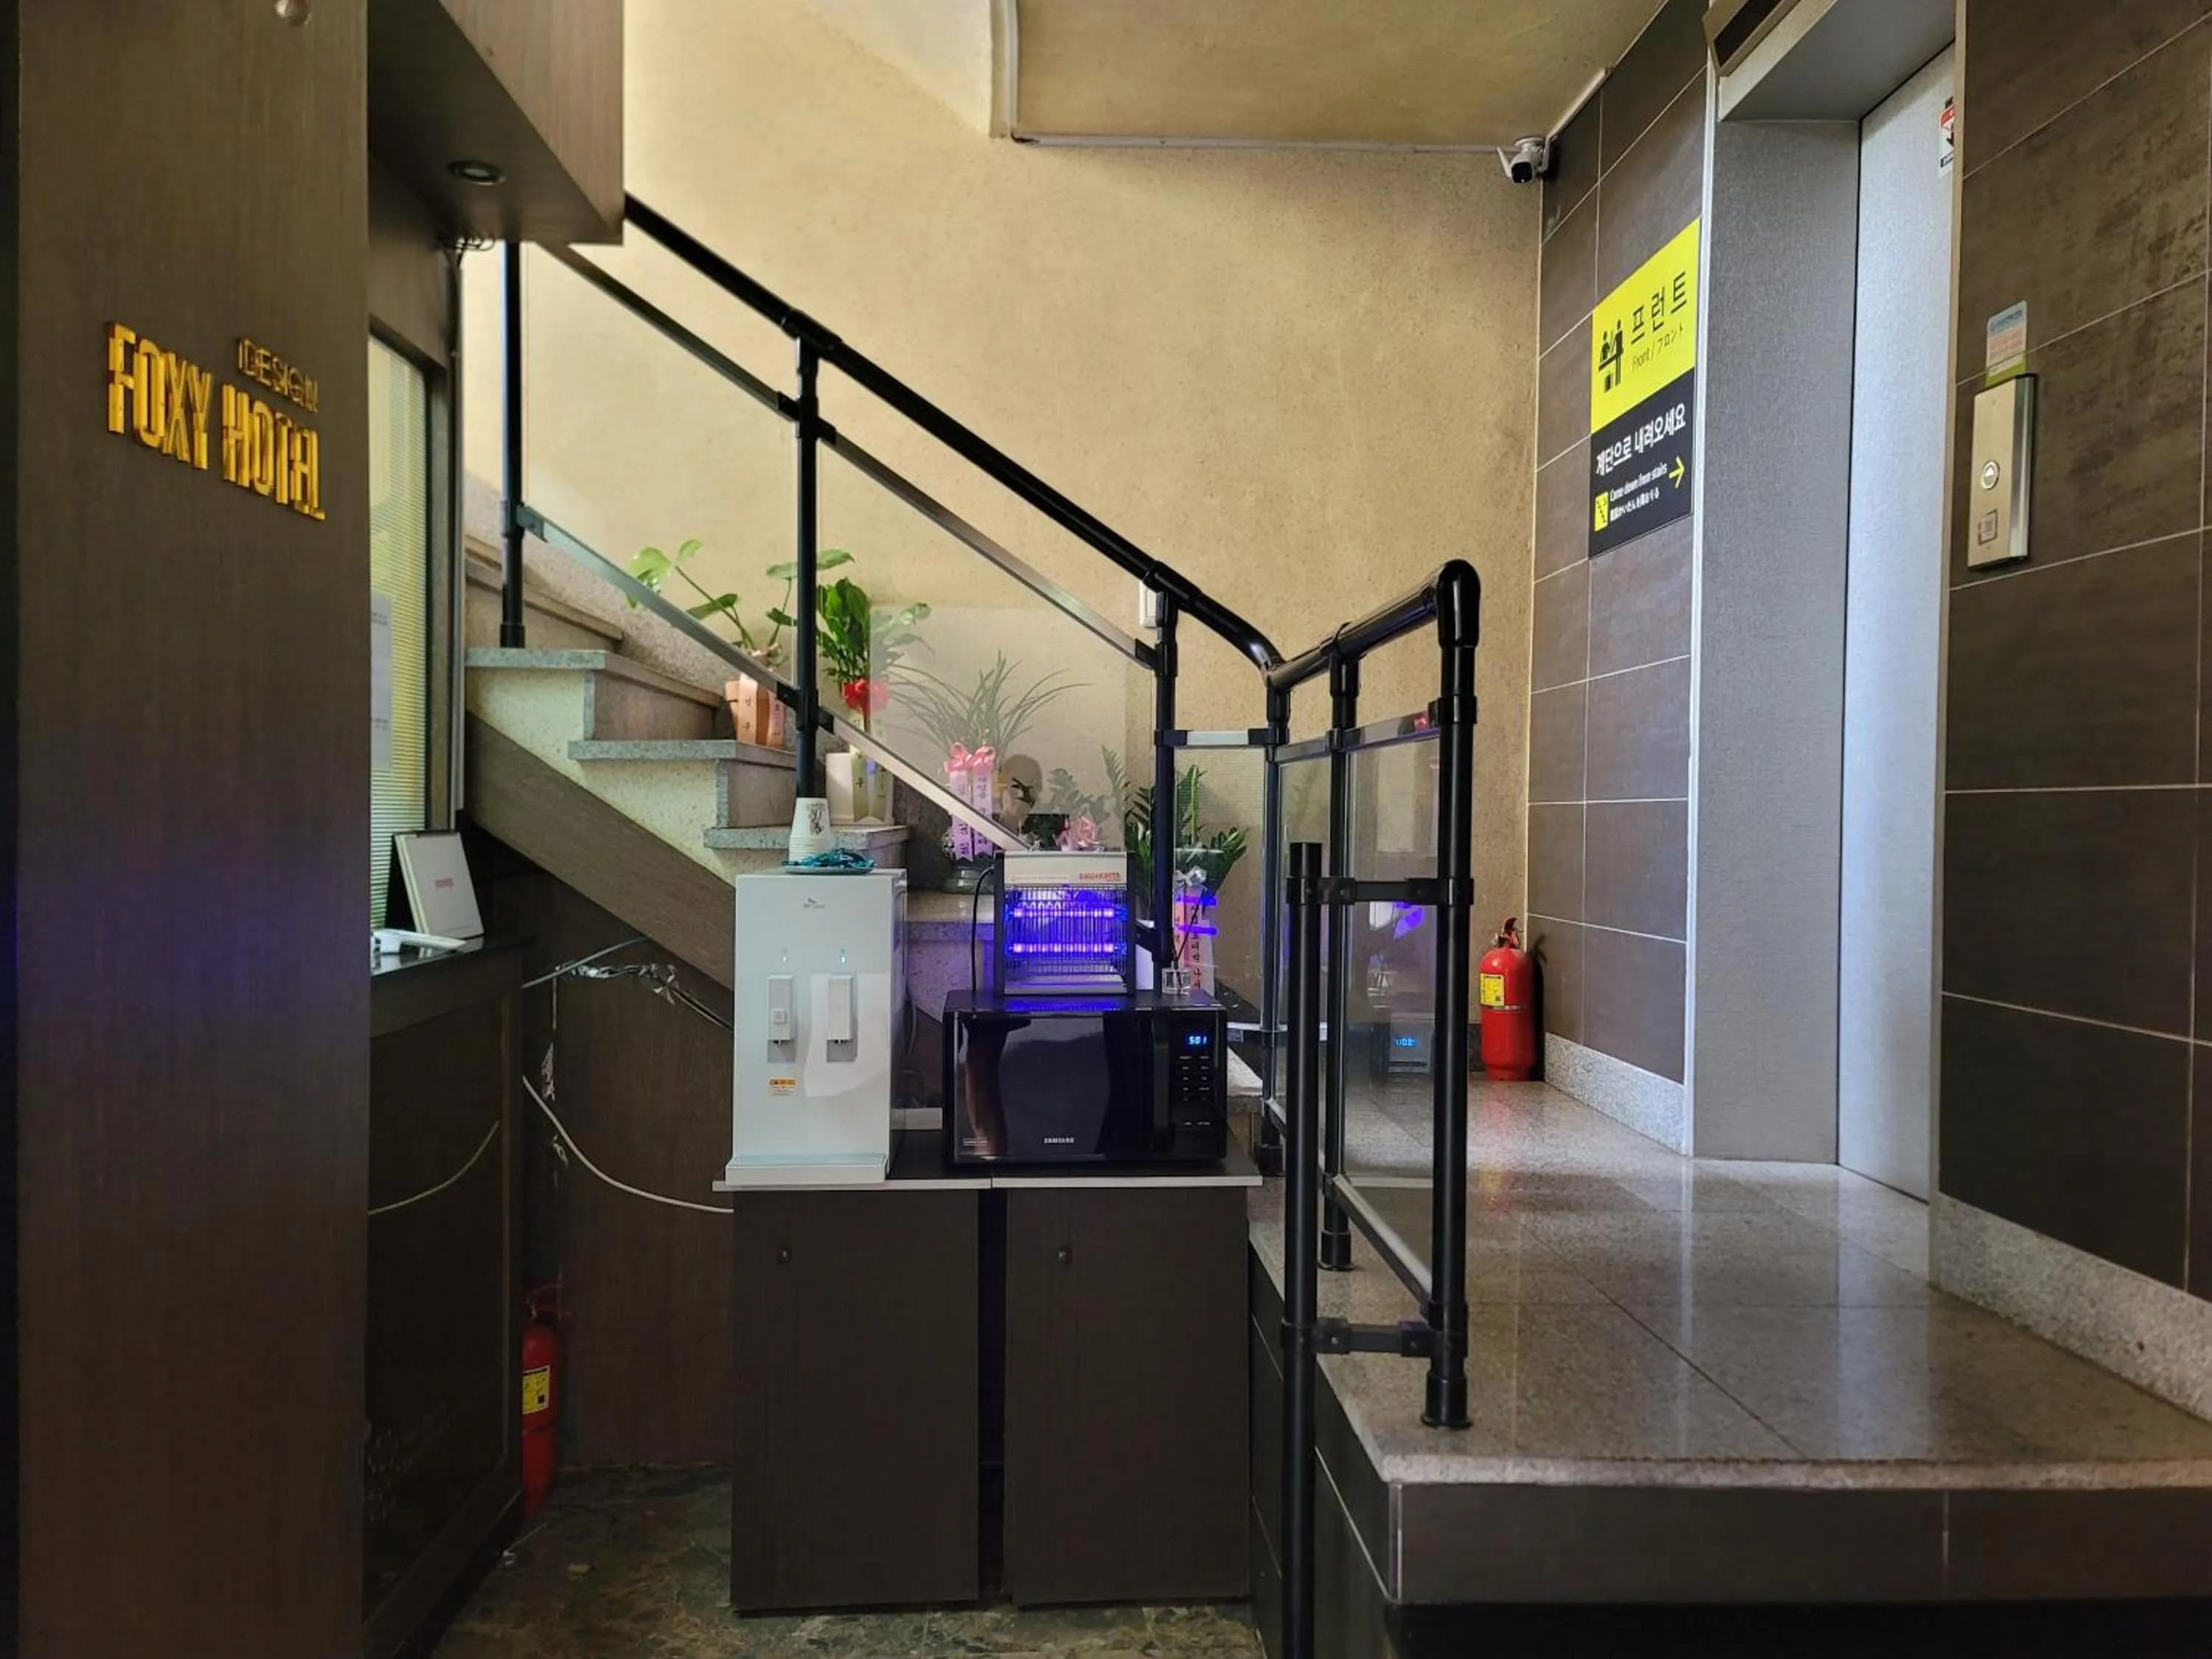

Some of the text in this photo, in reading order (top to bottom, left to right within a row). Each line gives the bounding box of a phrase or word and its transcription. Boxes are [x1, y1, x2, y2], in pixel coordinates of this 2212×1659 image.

[1631, 271, 1687, 345] 프런트
[237, 337, 319, 413] DESIGN
[1632, 347, 1650, 371] Front
[107, 321, 325, 520] FOXY HOTEL
[1596, 403, 1686, 476] 계단으로 내려오세요
